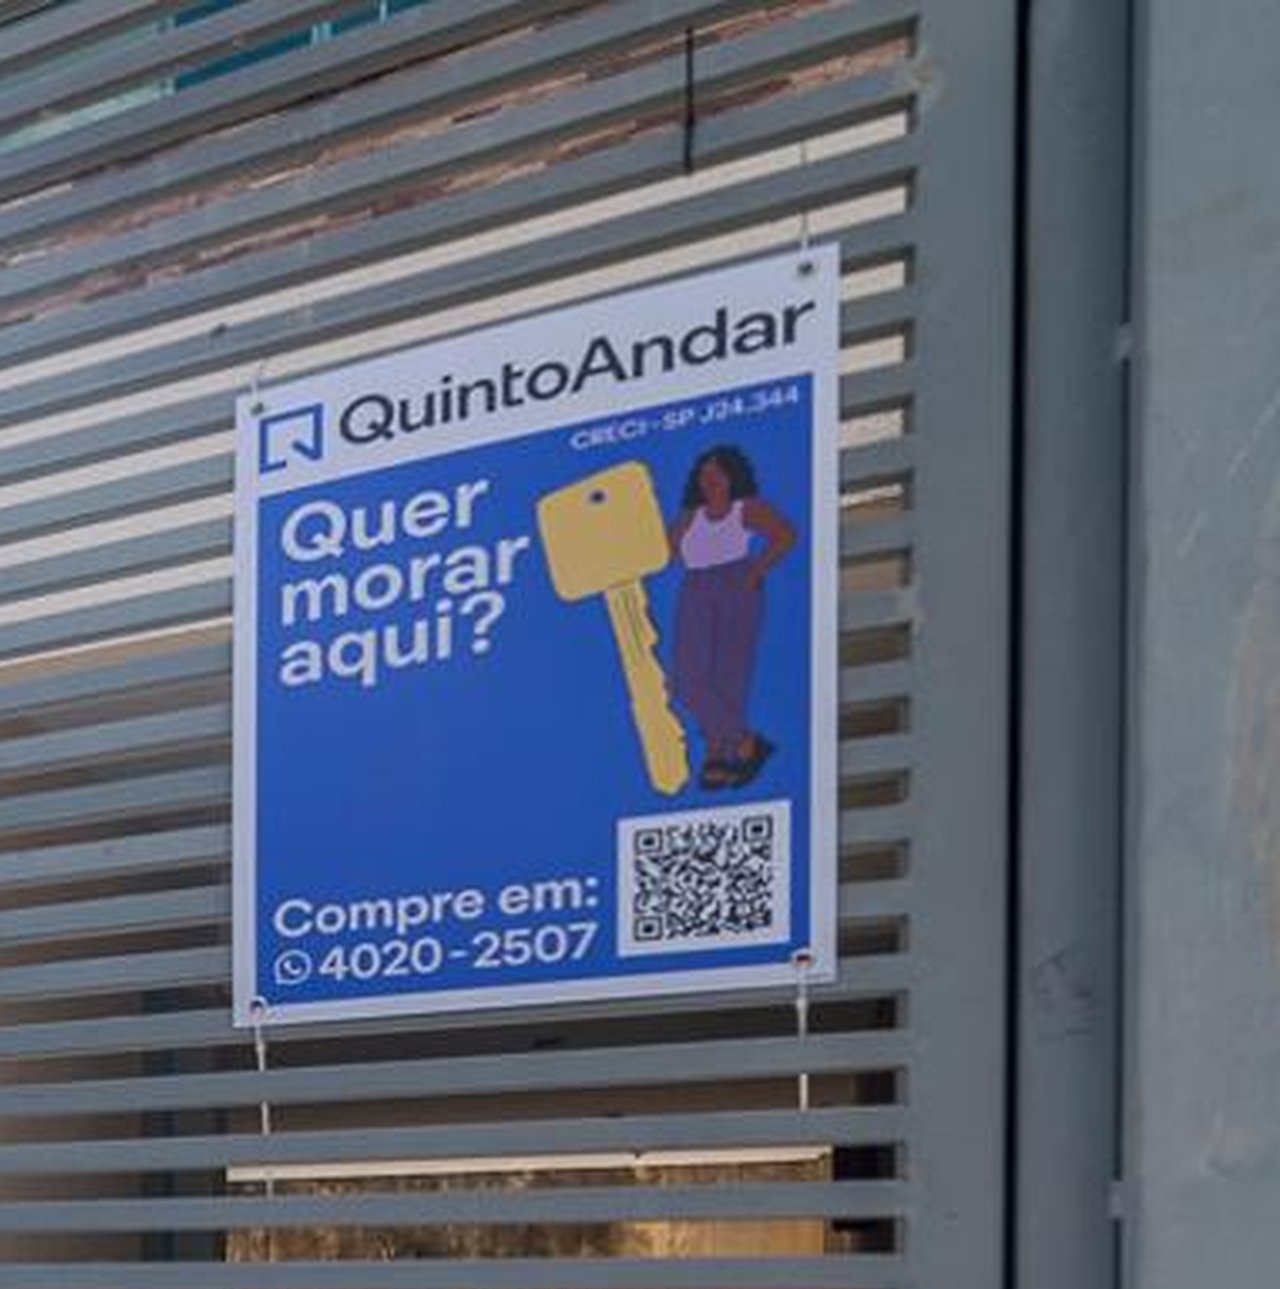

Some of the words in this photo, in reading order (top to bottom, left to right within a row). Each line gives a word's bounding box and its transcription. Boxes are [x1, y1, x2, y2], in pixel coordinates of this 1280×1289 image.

[339, 301, 816, 445] QuintoAndar
[281, 479, 489, 561] Quer
[281, 534, 530, 626] morar
[281, 592, 506, 687] aqui?
[274, 889, 483, 935] Compre
[499, 876, 599, 913] em:
